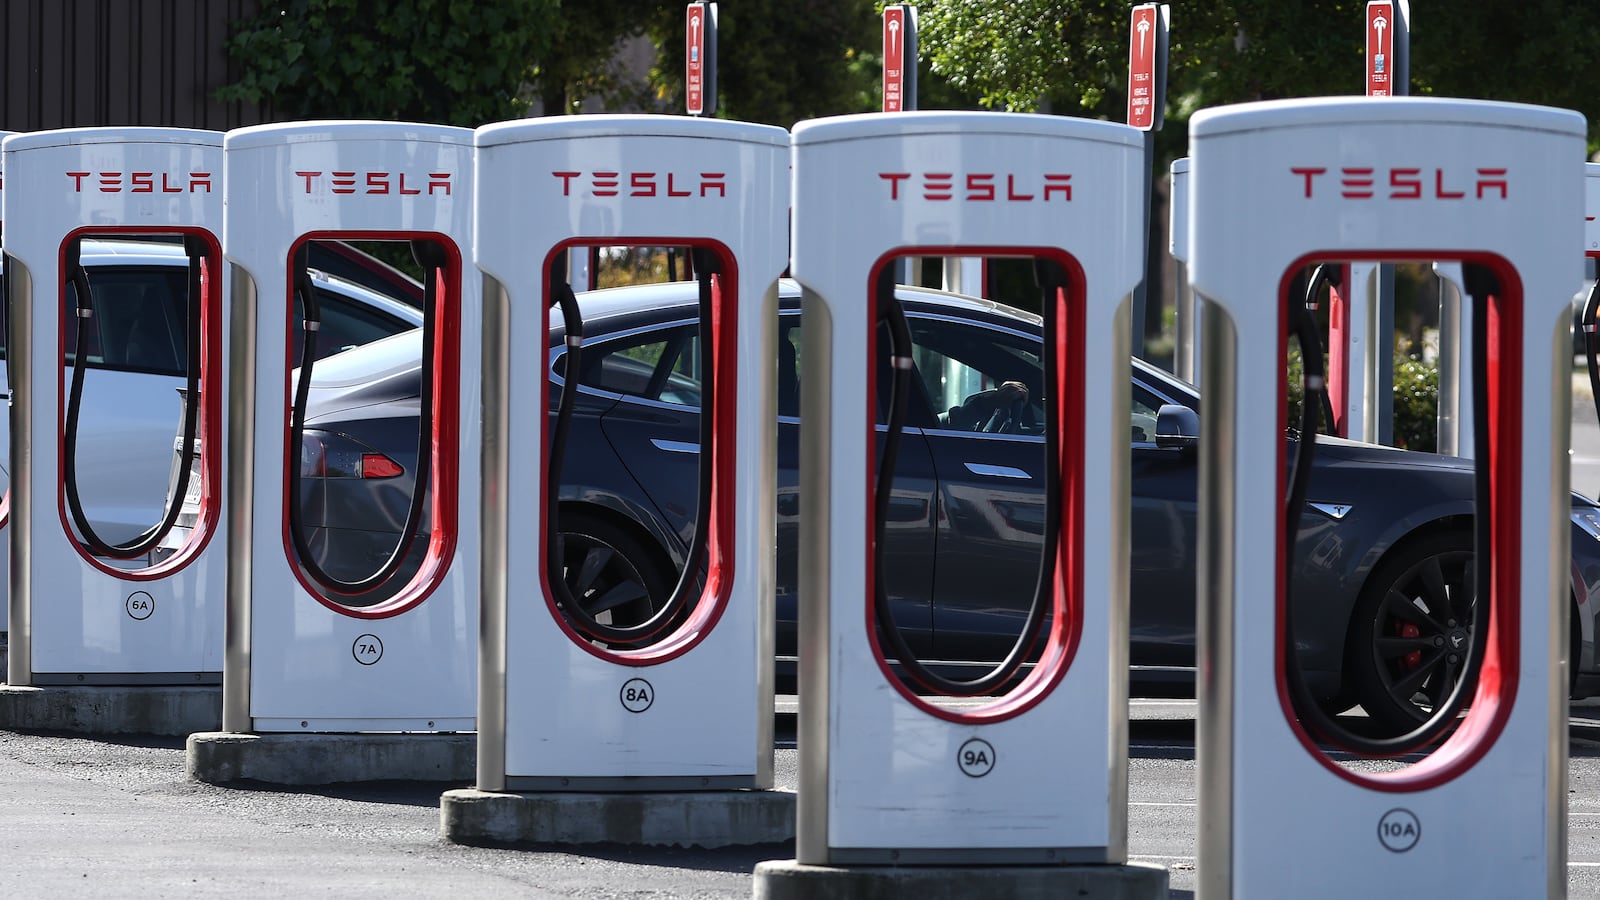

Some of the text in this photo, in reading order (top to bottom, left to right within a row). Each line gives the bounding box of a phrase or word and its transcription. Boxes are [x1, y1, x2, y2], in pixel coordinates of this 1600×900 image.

[1134, 72, 1149, 81] TESLA
[1372, 74, 1387, 82] TESLA
[66, 172, 211, 193] TESLA
[295, 171, 452, 195] TESLA
[552, 171, 726, 197] TESLA
[878, 173, 1073, 201] TESLA
[1291, 167, 1509, 200] TESLA
[132, 600, 149, 611] 6A
[359, 644, 377, 655] 7A
[625, 687, 650, 703] 8A
[963, 750, 990, 767] 9A
[1383, 822, 1417, 838] 10A
